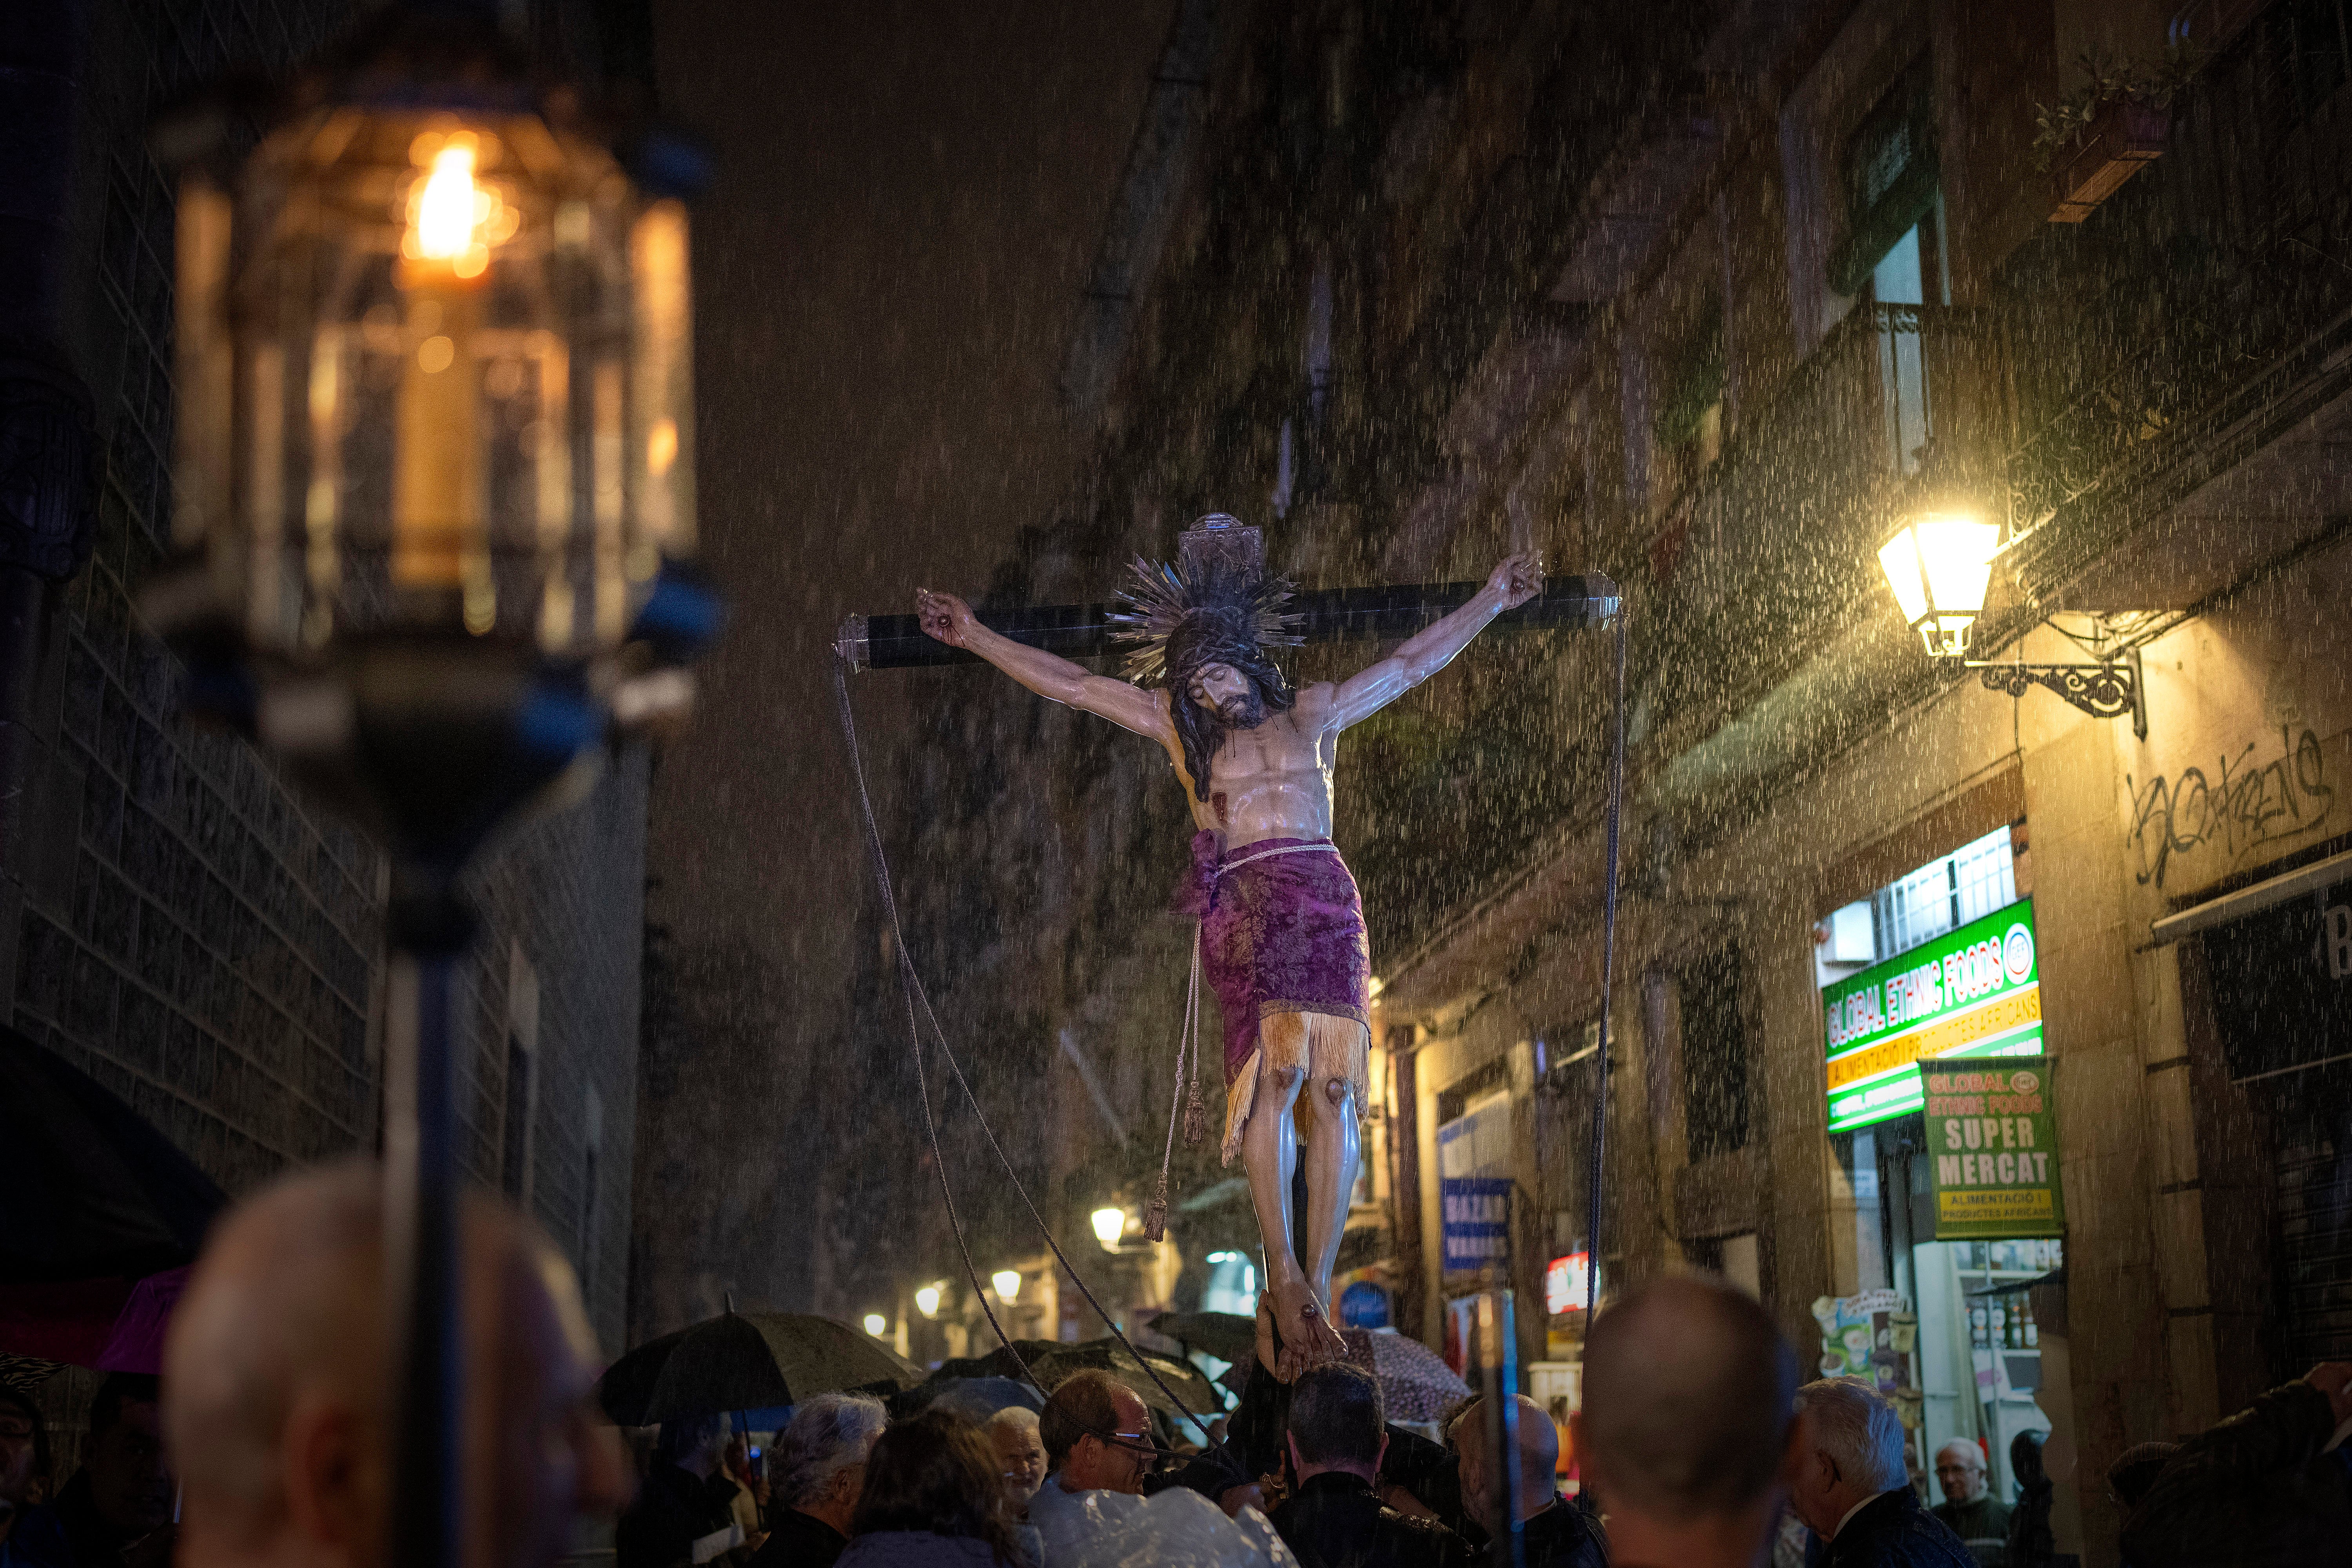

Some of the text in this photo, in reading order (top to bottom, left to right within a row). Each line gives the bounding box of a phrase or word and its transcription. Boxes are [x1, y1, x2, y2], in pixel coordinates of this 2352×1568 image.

[1827, 935, 2004, 1048] GLOBAL ETHNIC FOODS
[1980, 995, 2038, 1033] AFRCANS
[1929, 1073, 2009, 1094] GLOBAL
[1929, 1096, 1986, 1116] ETHNIC
[1989, 1094, 2043, 1114] FOODS
[1945, 1117, 2035, 1150] SUPER
[1938, 1152, 2048, 1185] MERCAT
[1951, 1192, 2034, 1205] ALIMENTACIÓ
